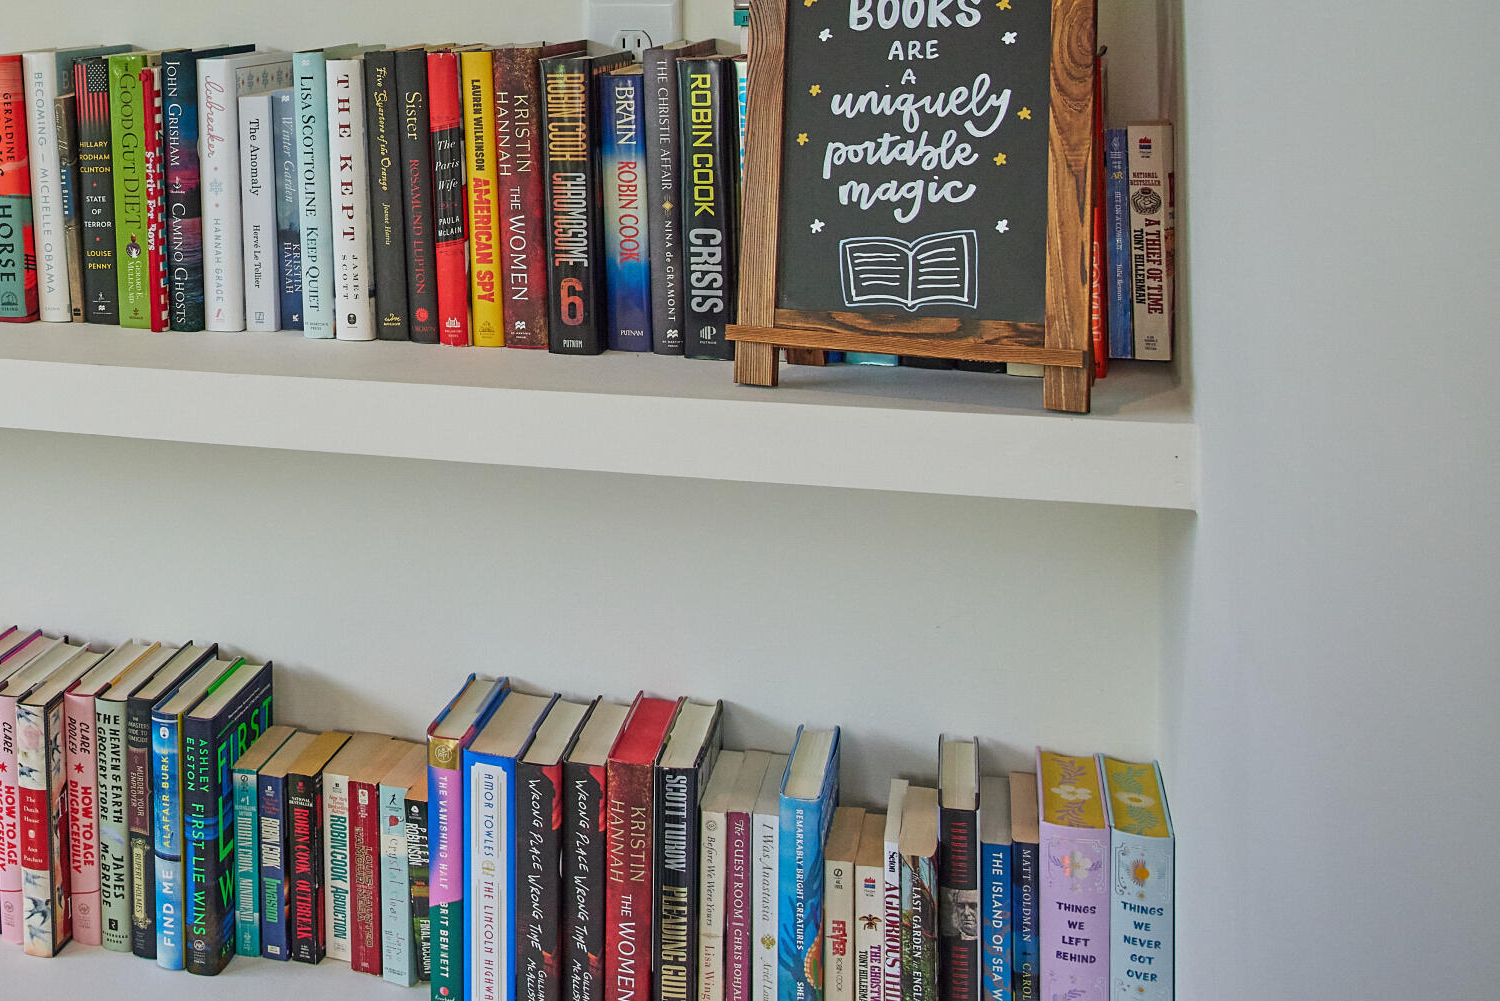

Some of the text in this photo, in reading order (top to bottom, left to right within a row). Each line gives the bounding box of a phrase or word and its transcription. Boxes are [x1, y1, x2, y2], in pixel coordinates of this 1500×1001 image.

[888, 40, 939, 60] ARE
[901, 69, 916, 84] A
[3, 93, 14, 161] GERALDINE
[406, 92, 423, 140] Sister
[830, 73, 1012, 138] uniquely
[119, 74, 140, 229] GOOD GUT DIET
[250, 119, 259, 142] The
[437, 140, 455, 151] The
[497, 91, 512, 176] HANNAH
[513, 94, 531, 173] KRISTIN
[822, 129, 978, 179] portable
[34, 72, 54, 294] BECOMING MICHELLE OBAMA
[250, 143, 261, 196] Anomaly
[435, 159, 459, 171] Paris
[438, 179, 458, 192] Wife
[615, 86, 640, 262] BRAIN ROBIN COOK
[166, 62, 188, 324] JOHN GRISHAM CAMINO GHOSTS
[300, 76, 320, 311] LISA SCOTTOLINE KEEP QUIET
[471, 79, 495, 303] LAUREN WILKINSON AMERICAN SPY
[689, 74, 724, 313] ROBIN COOK CRISIS
[838, 175, 977, 223] magic
[439, 217, 460, 225] PAULA
[510, 186, 528, 301] THE WOMEN
[254, 251, 260, 259] Le
[186, 738, 195, 791] ELSTON
[198, 740, 208, 793] ASHLEY
[192, 804, 206, 936] FIRST LIE WINS
[329, 815, 348, 939] ROBIN COOK ABDUCTION
[1022, 849, 1031, 942] MATT GOLDMAN
[1056, 902, 1096, 914] THINGS
[1120, 901, 1163, 916] THINGS
[1061, 936, 1089, 947] LEFT
[1068, 920, 1084, 930] WE
[1123, 935, 1161, 949] NEVER
[1133, 920, 1151, 931] WE
[1055, 951, 1096, 964] BEHIND
[1126, 969, 1158, 982] OVER
[1130, 954, 1154, 965] GOT
